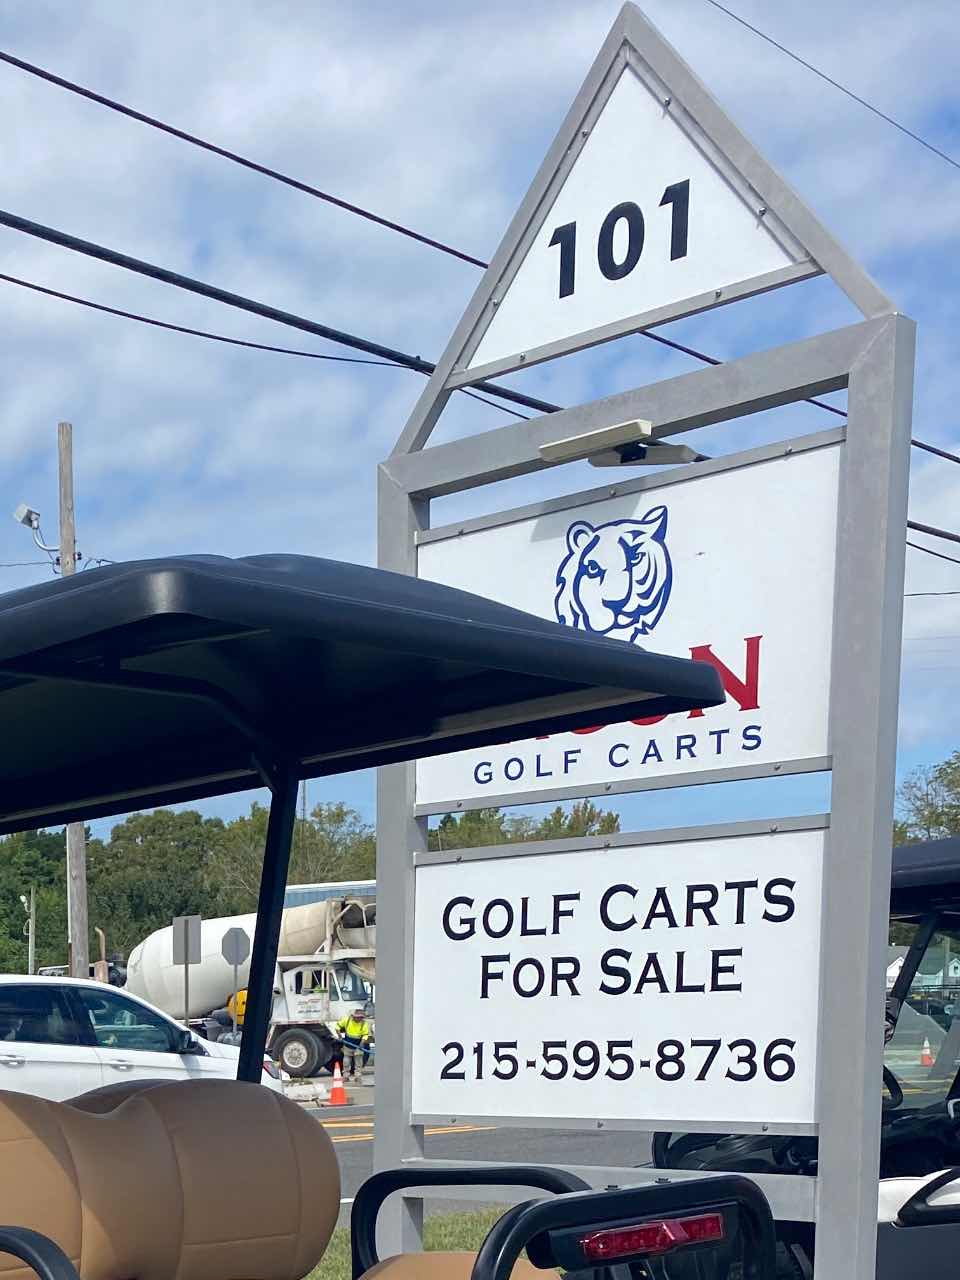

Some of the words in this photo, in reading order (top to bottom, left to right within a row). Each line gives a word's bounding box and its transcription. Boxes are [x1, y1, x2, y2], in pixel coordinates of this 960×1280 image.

[547, 178, 690, 299] 101
[474, 748, 582, 785] GOLF
[608, 725, 763, 769] CARTS
[442, 891, 581, 941] GOLF
[599, 877, 796, 932] CARTS
[479, 952, 581, 999] FOR
[598, 947, 743, 996] SALE
[440, 1038, 797, 1082] 215-595-8736
